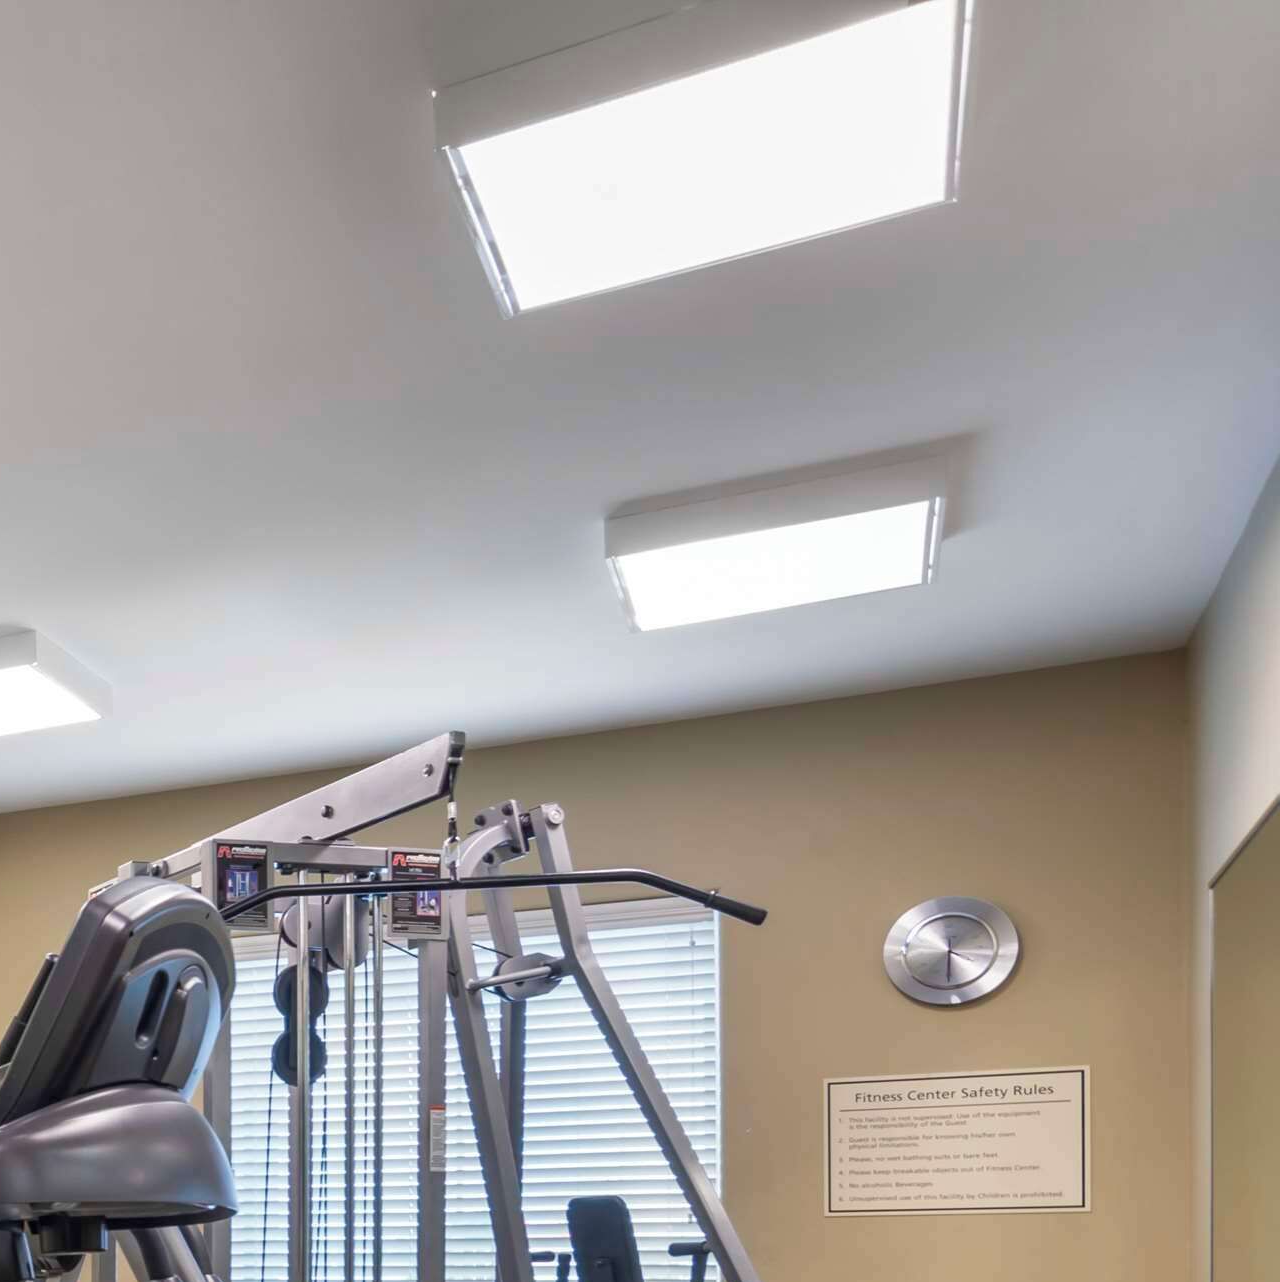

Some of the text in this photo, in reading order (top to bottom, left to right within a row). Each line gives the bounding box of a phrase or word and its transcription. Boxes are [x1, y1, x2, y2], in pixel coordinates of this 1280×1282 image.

[854, 1083, 1055, 1103] Fitness Center Safety Rules
